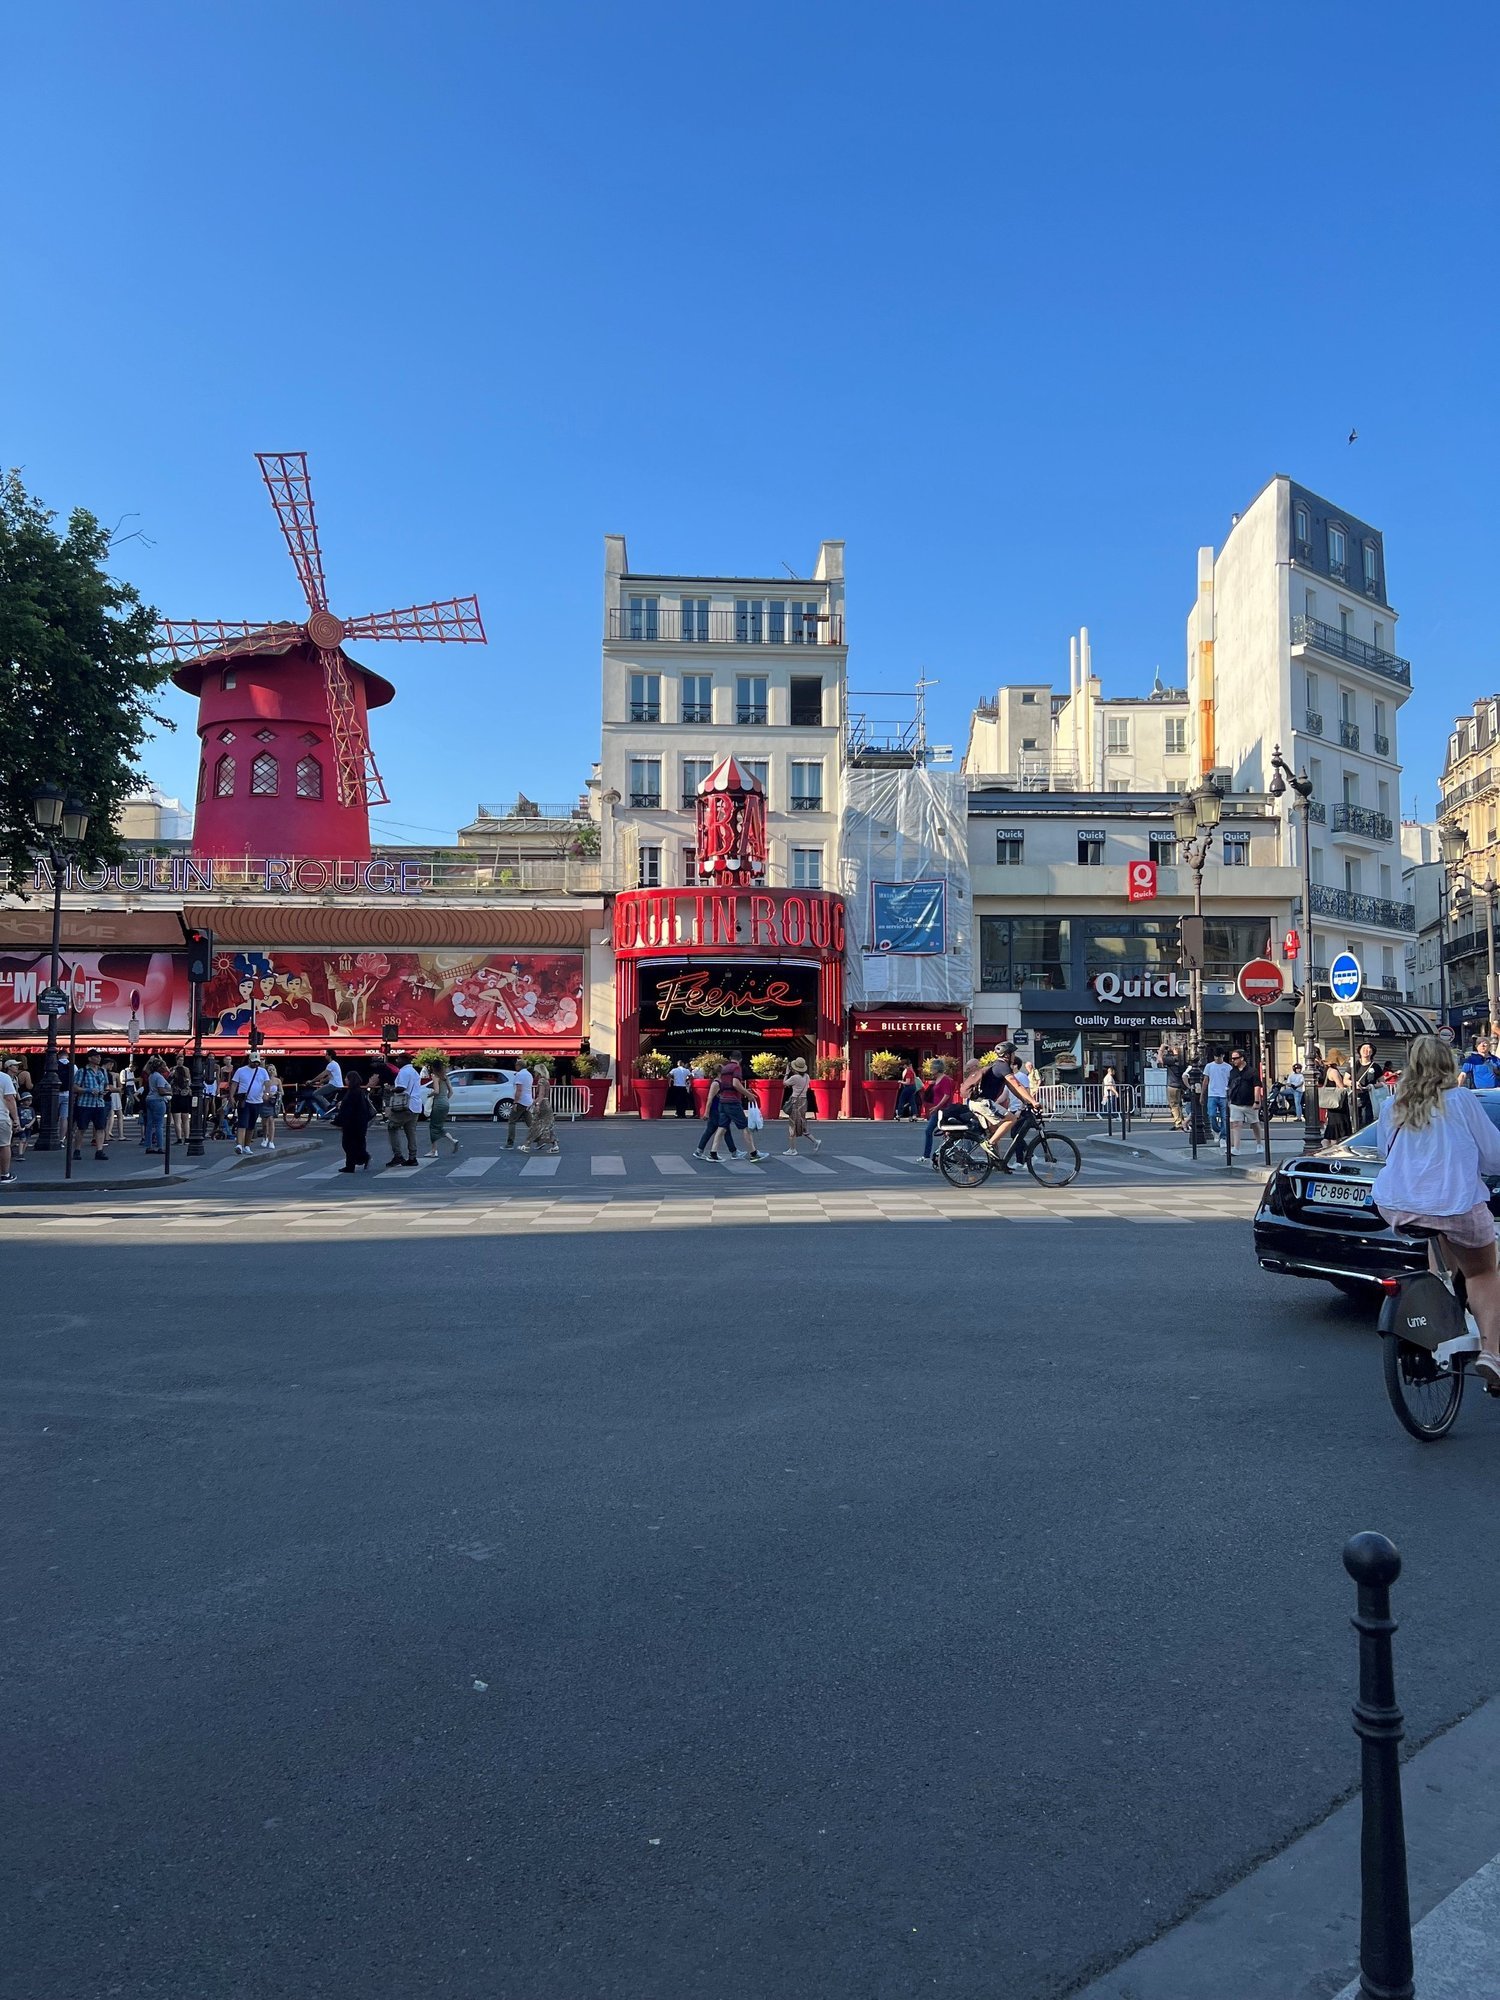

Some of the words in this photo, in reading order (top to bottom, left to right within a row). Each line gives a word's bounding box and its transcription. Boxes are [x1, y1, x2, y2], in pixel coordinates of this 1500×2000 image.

[997, 830, 1023, 839] Quick
[1078, 831, 1104, 840] Quick
[1150, 832, 1175, 841] Quick
[1223, 832, 1249, 841] Quick
[34, 857, 213, 891] MOULIN
[264, 859, 423, 893] ROUGE
[722, 871, 751, 886] DU
[1133, 864, 1153, 887] Q
[1133, 890, 1153, 899] Quick
[656, 970, 803, 1022] Féerie
[1074, 1015, 1109, 1026] Quality
[1113, 1015, 1146, 1026] Burger
[1150, 1015, 1177, 1026] Resta
[881, 1022, 942, 1031] BILLETTERIE
